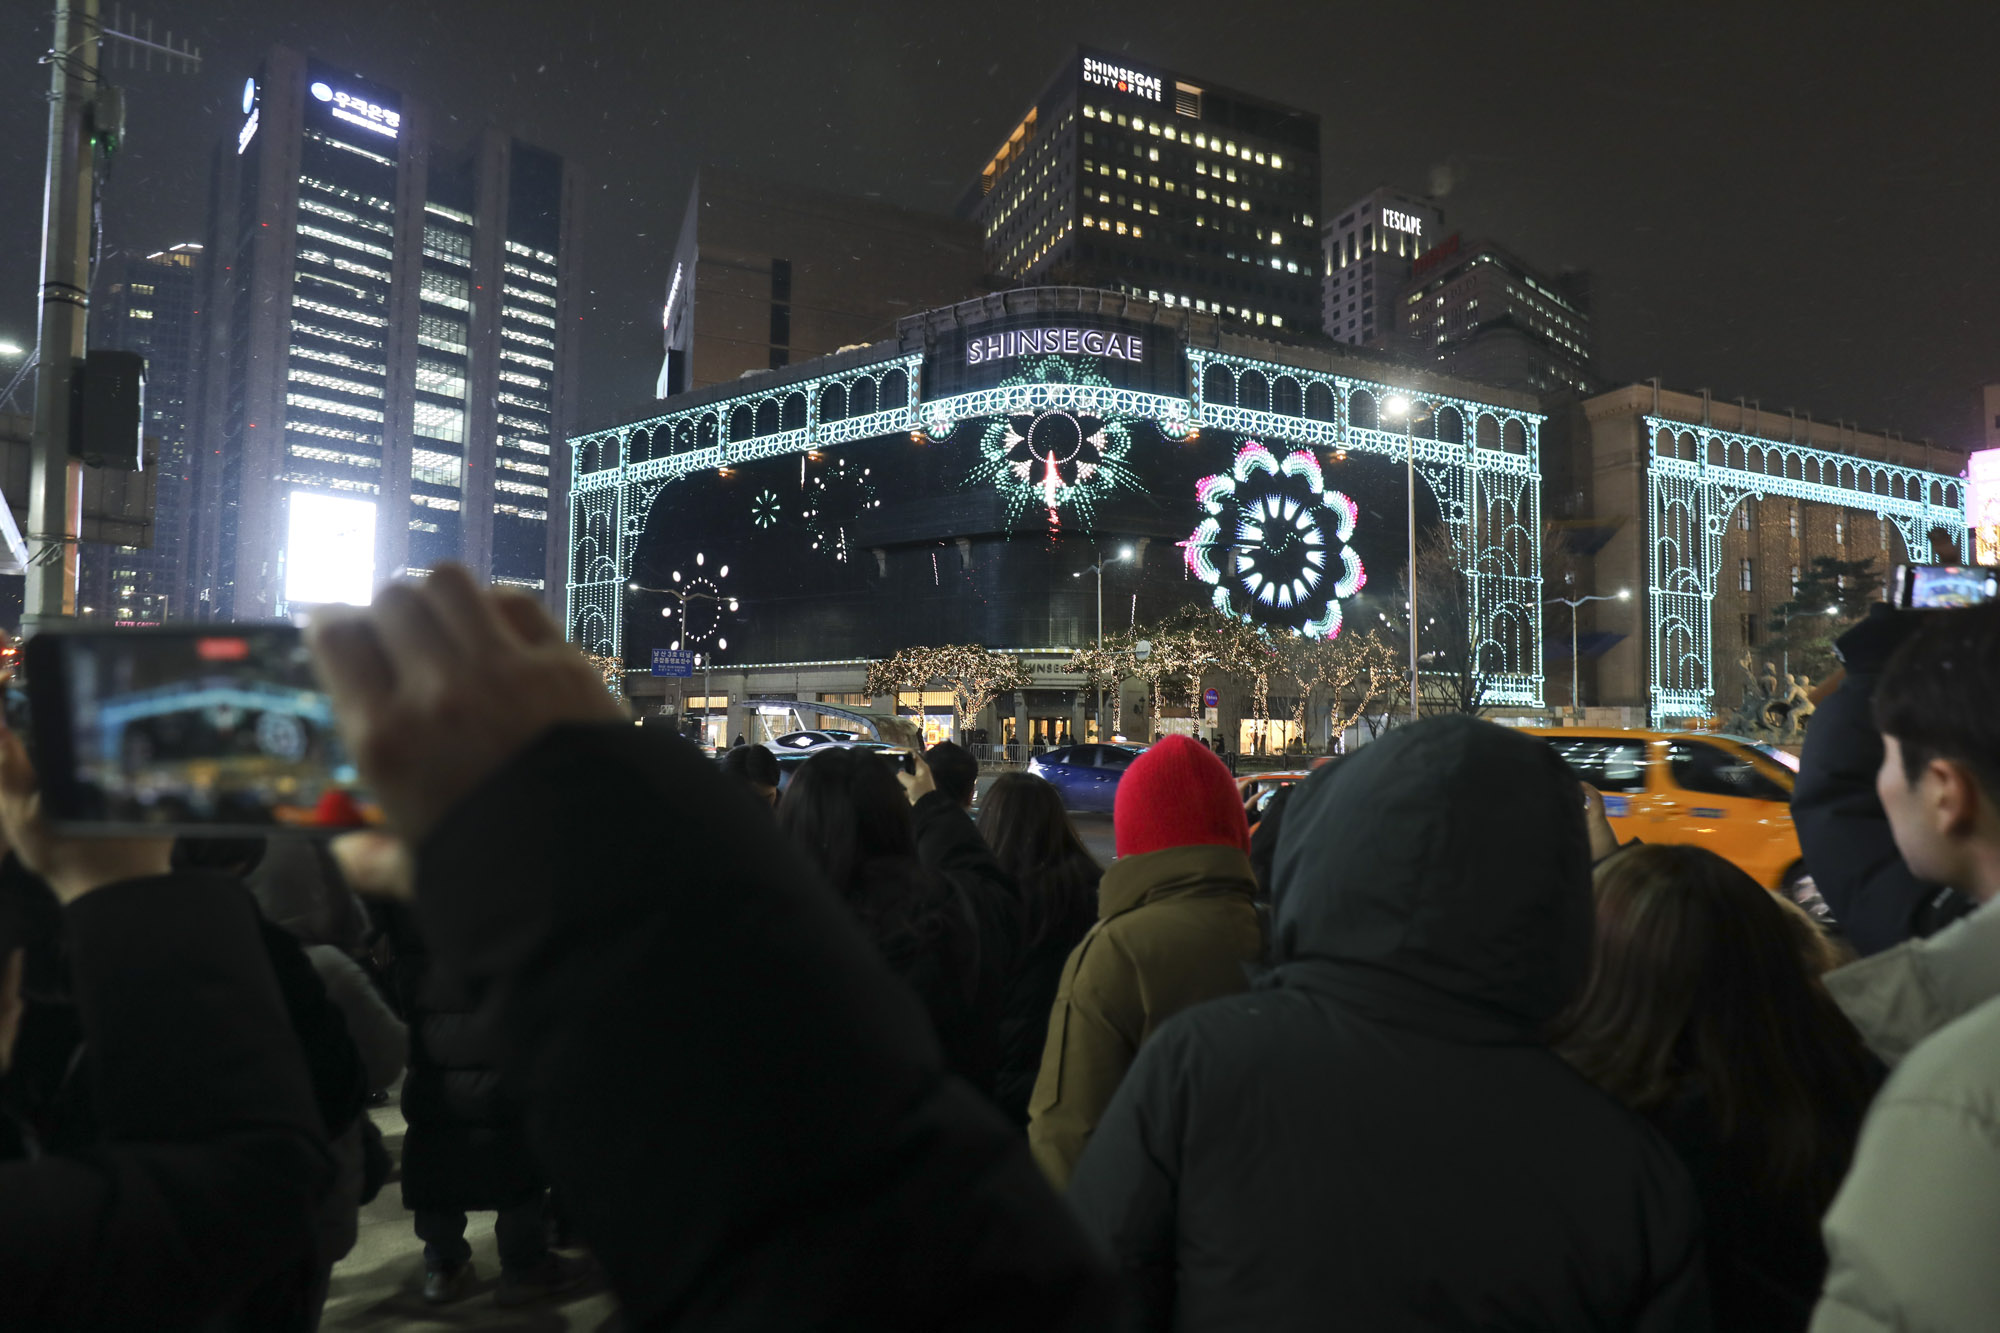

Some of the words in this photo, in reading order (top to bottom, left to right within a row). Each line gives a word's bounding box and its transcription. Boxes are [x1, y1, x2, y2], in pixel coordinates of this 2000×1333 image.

[1083, 57, 1162, 93] SHINSEGAE
[1083, 70, 1118, 90] DUTY
[1127, 83, 1162, 102] FREE
[333, 91, 401, 128] 우리은행
[1382, 207, 1422, 236] L'ESCAPE
[967, 327, 1143, 366] SHINSEGAE
